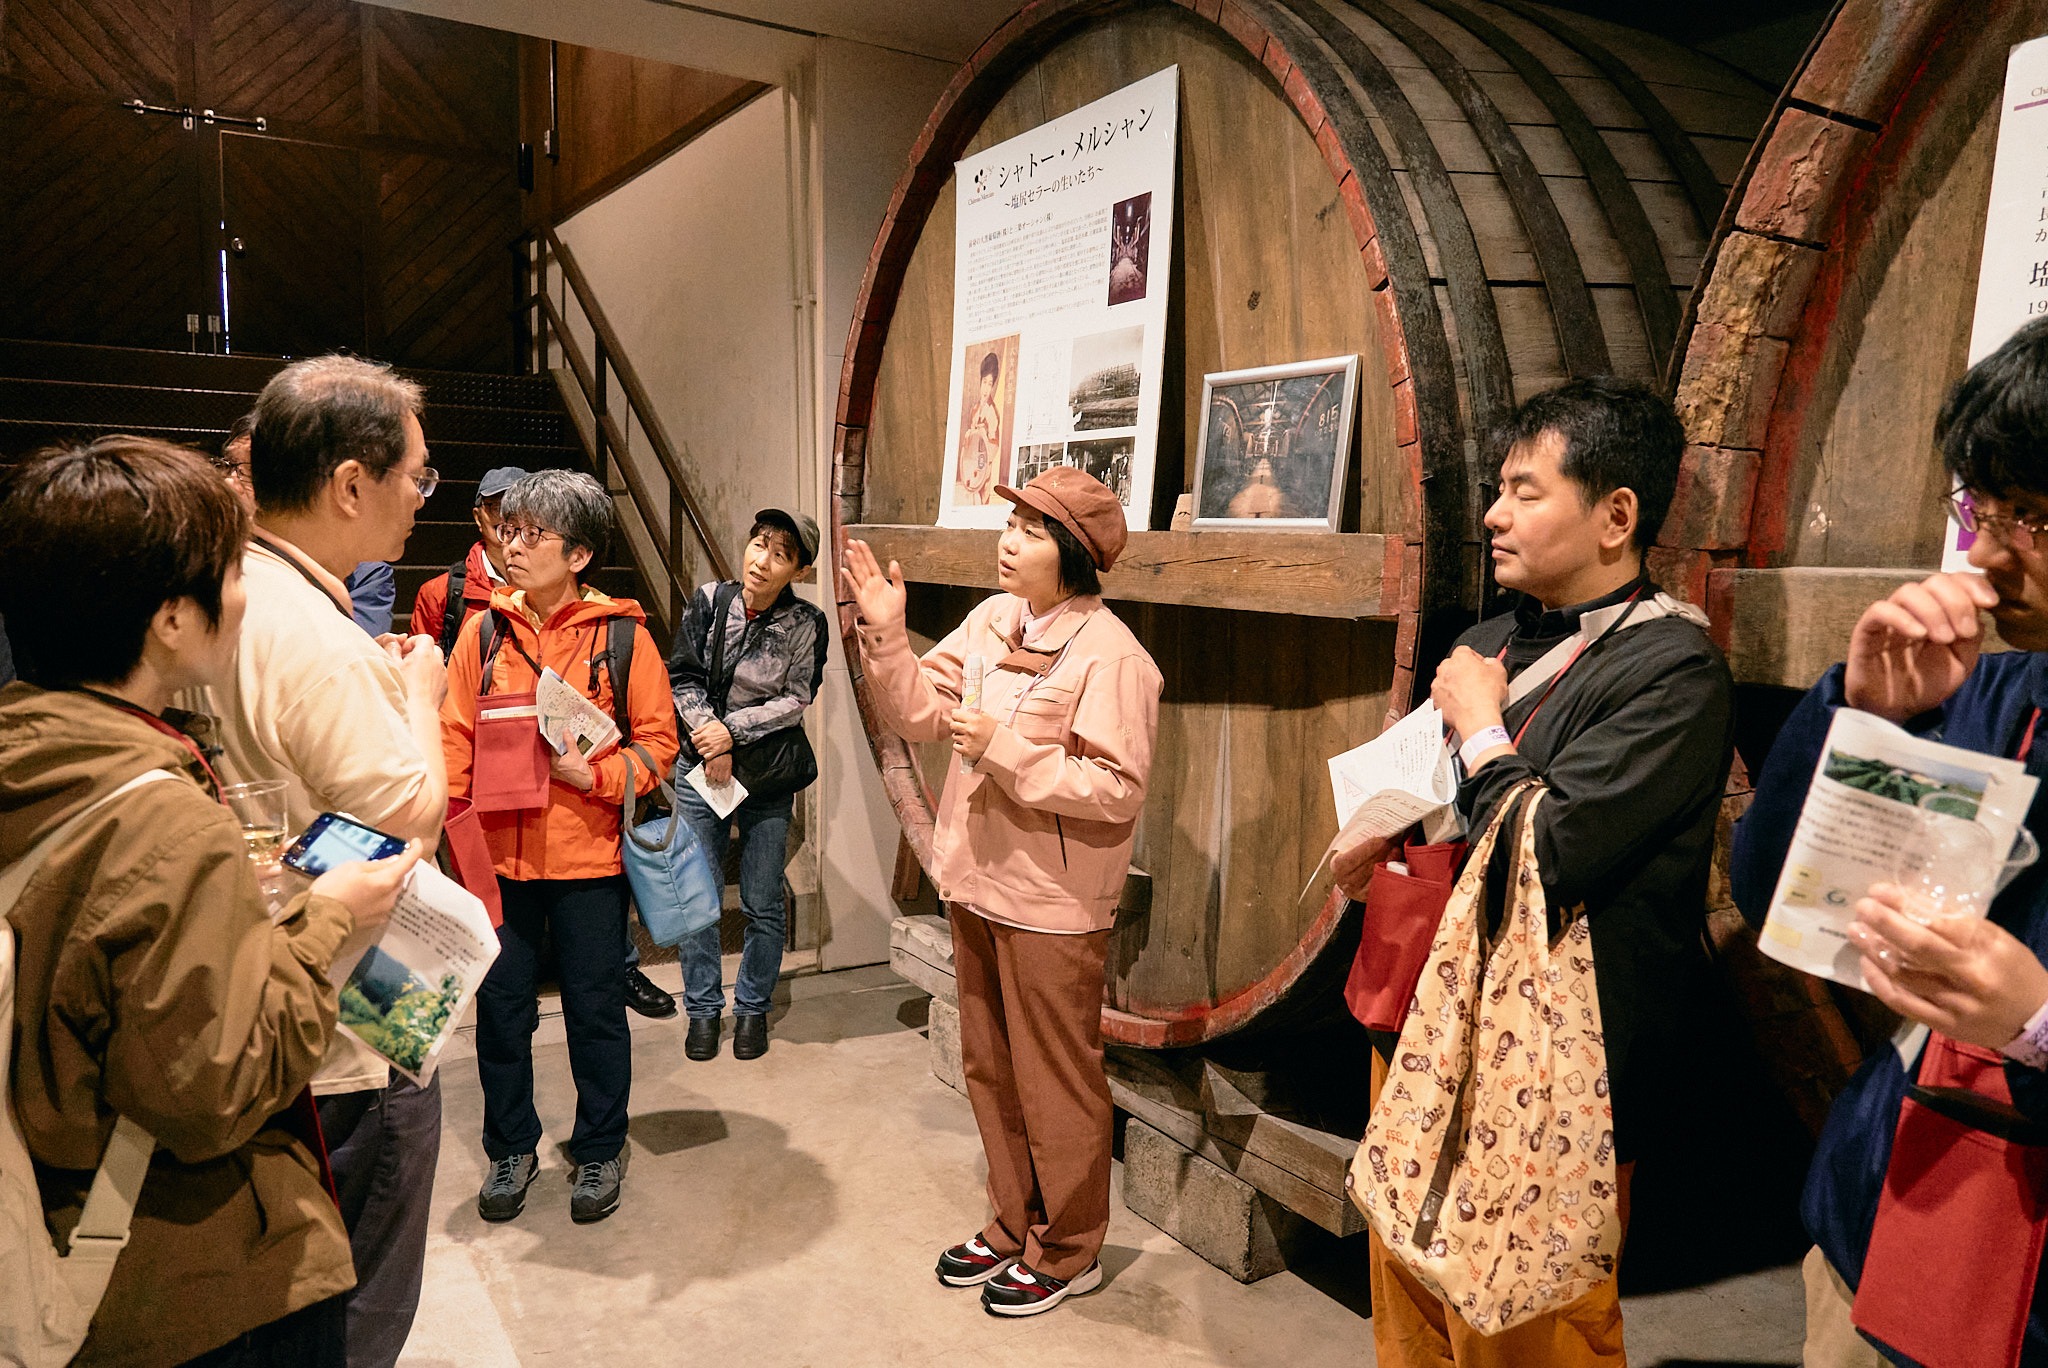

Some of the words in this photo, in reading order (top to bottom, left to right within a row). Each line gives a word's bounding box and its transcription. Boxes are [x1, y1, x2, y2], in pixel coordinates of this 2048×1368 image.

[999, 105, 1154, 189] シャトー・メルシャン
[1318, 403, 1339, 427] 815
